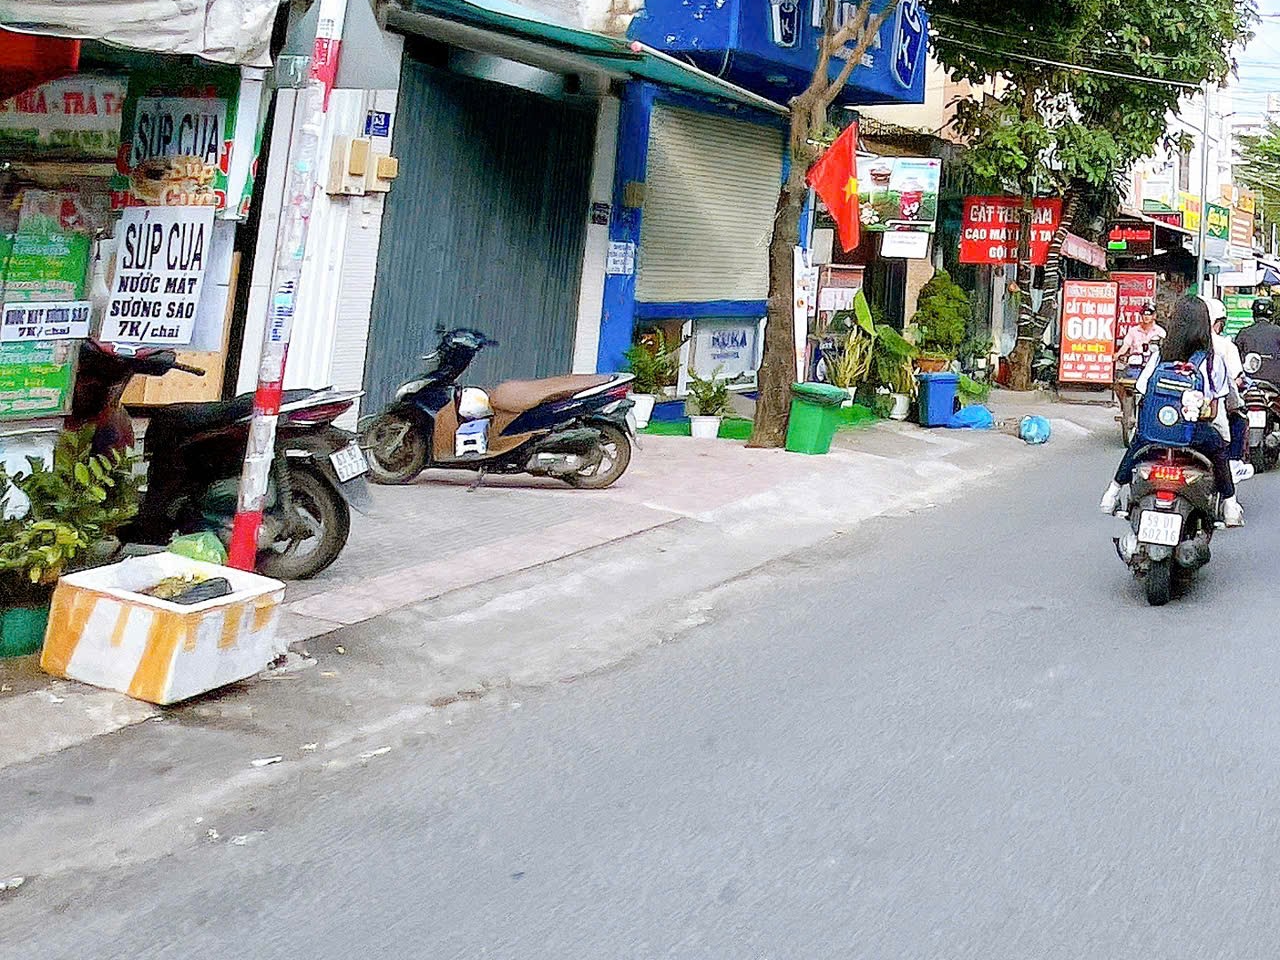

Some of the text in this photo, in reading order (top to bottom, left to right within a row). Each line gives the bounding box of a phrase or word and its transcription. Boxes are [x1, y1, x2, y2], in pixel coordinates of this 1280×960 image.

[122, 209, 204, 271] SÚP CUA
[117, 272, 198, 294] NƯỚC MÁT
[166, 297, 195, 319] SÁO
[1066, 316, 1115, 341] 60K
